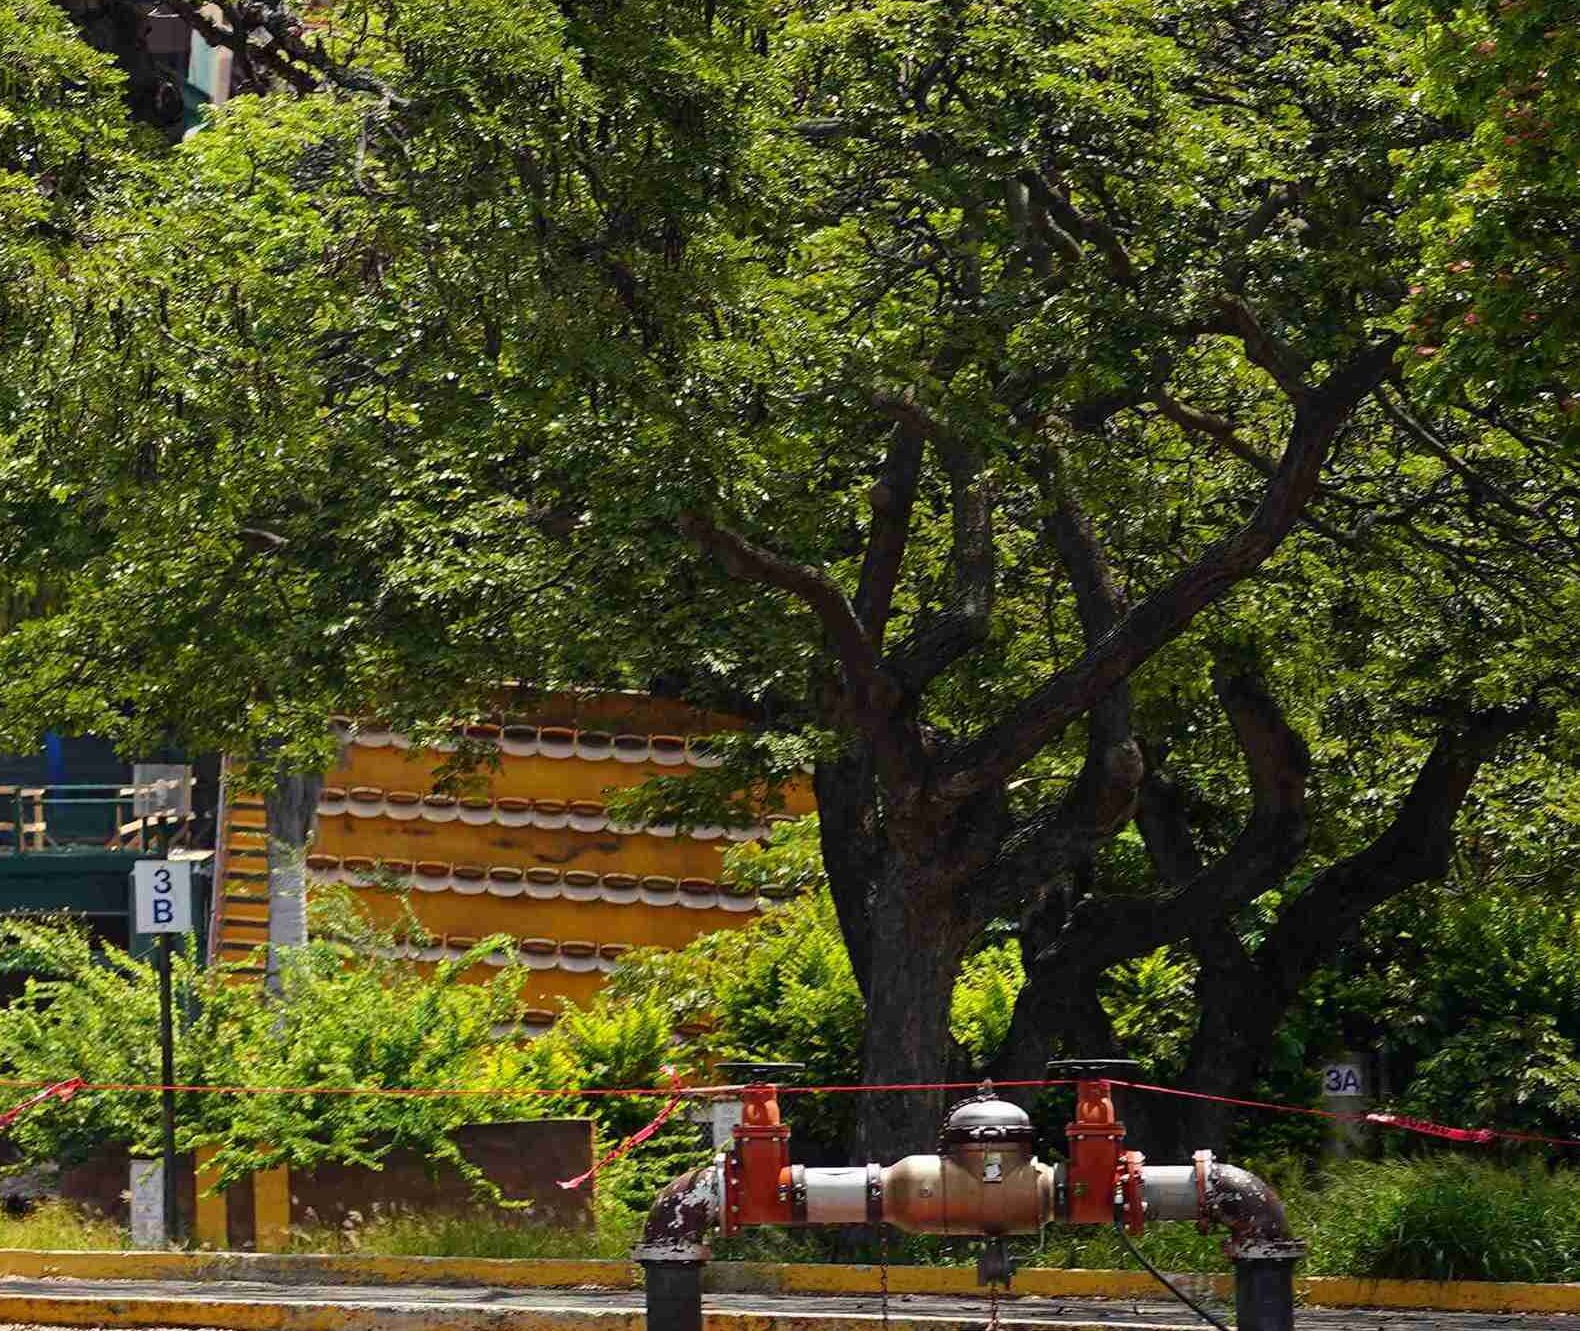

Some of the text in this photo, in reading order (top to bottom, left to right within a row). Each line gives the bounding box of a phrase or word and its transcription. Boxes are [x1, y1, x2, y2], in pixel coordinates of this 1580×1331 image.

[153, 869, 172, 894] 3
[153, 899, 173, 924] B
[1326, 1069, 1360, 1092] 3A
